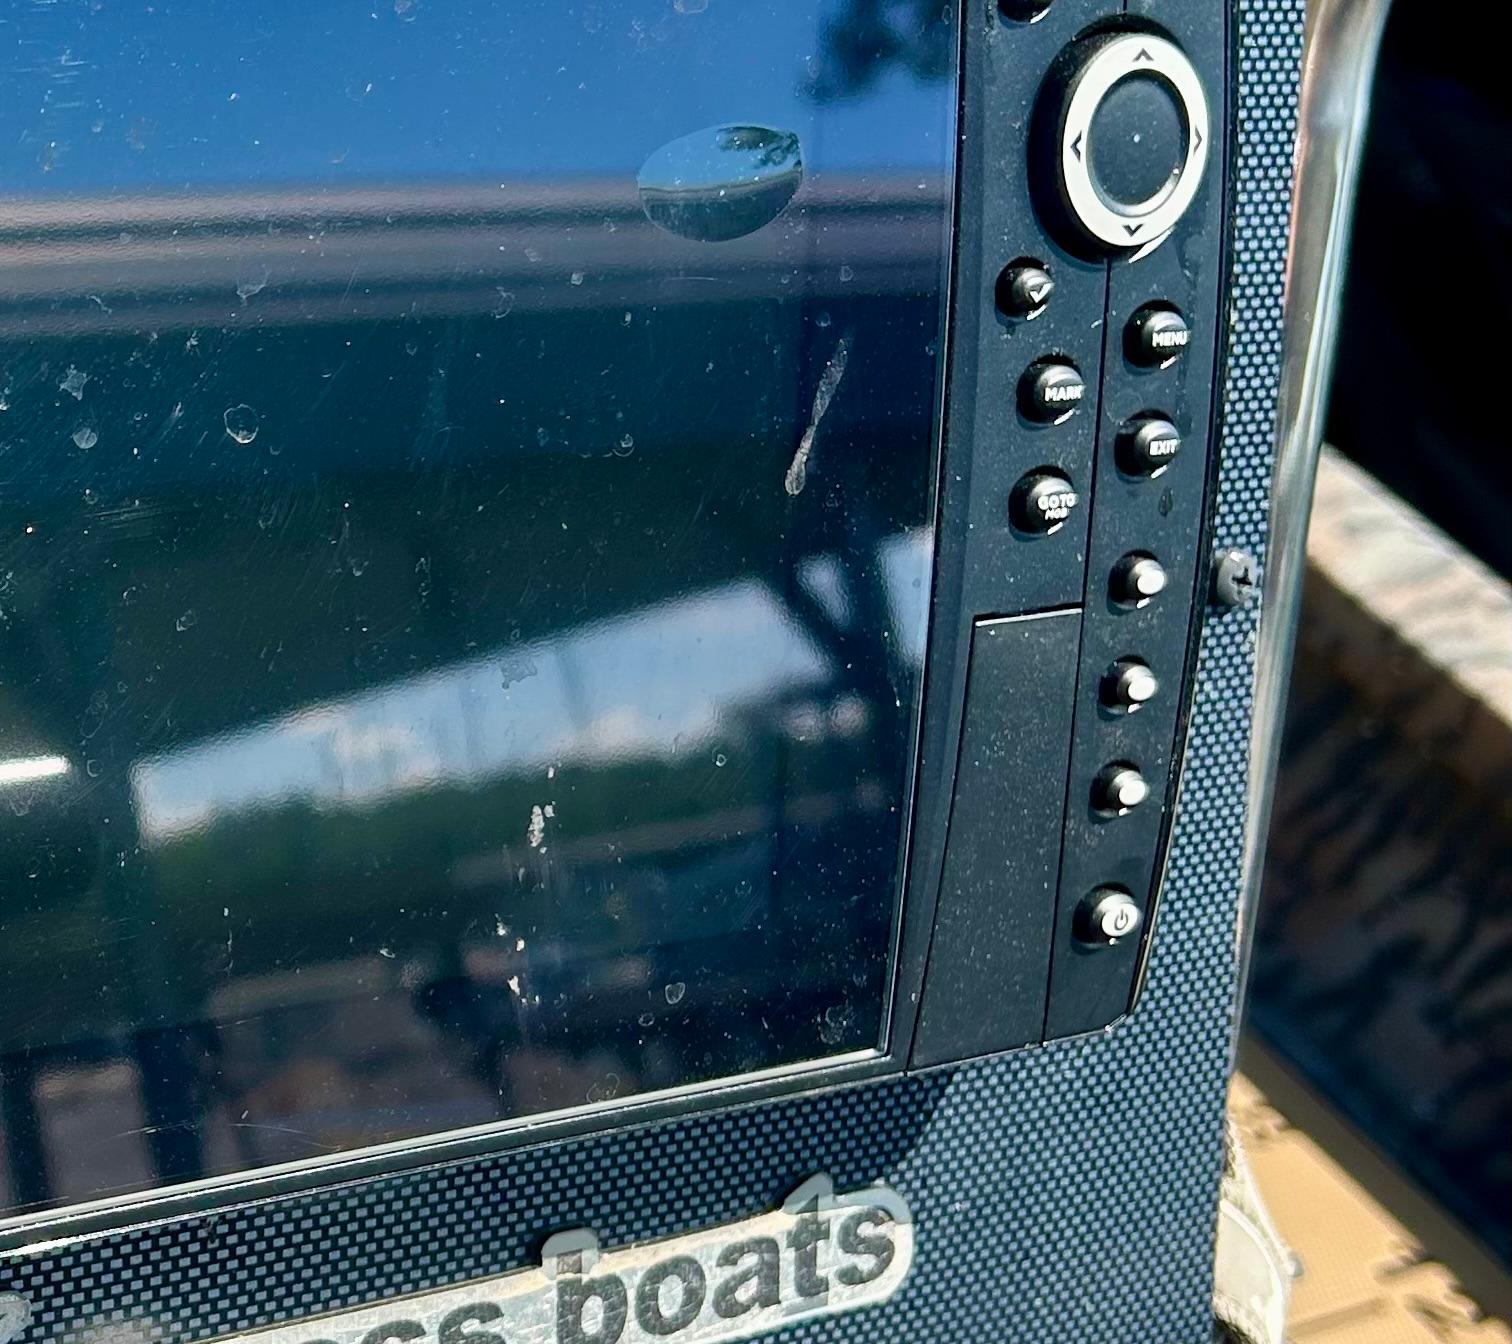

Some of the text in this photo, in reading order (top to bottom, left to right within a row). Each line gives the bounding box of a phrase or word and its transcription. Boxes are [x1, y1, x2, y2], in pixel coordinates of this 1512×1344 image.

[1152, 330, 1188, 347] MENU
[1044, 384, 1084, 402] MARK
[1149, 438, 1178, 456] EXIT
[1037, 492, 1078, 511] GOTO
